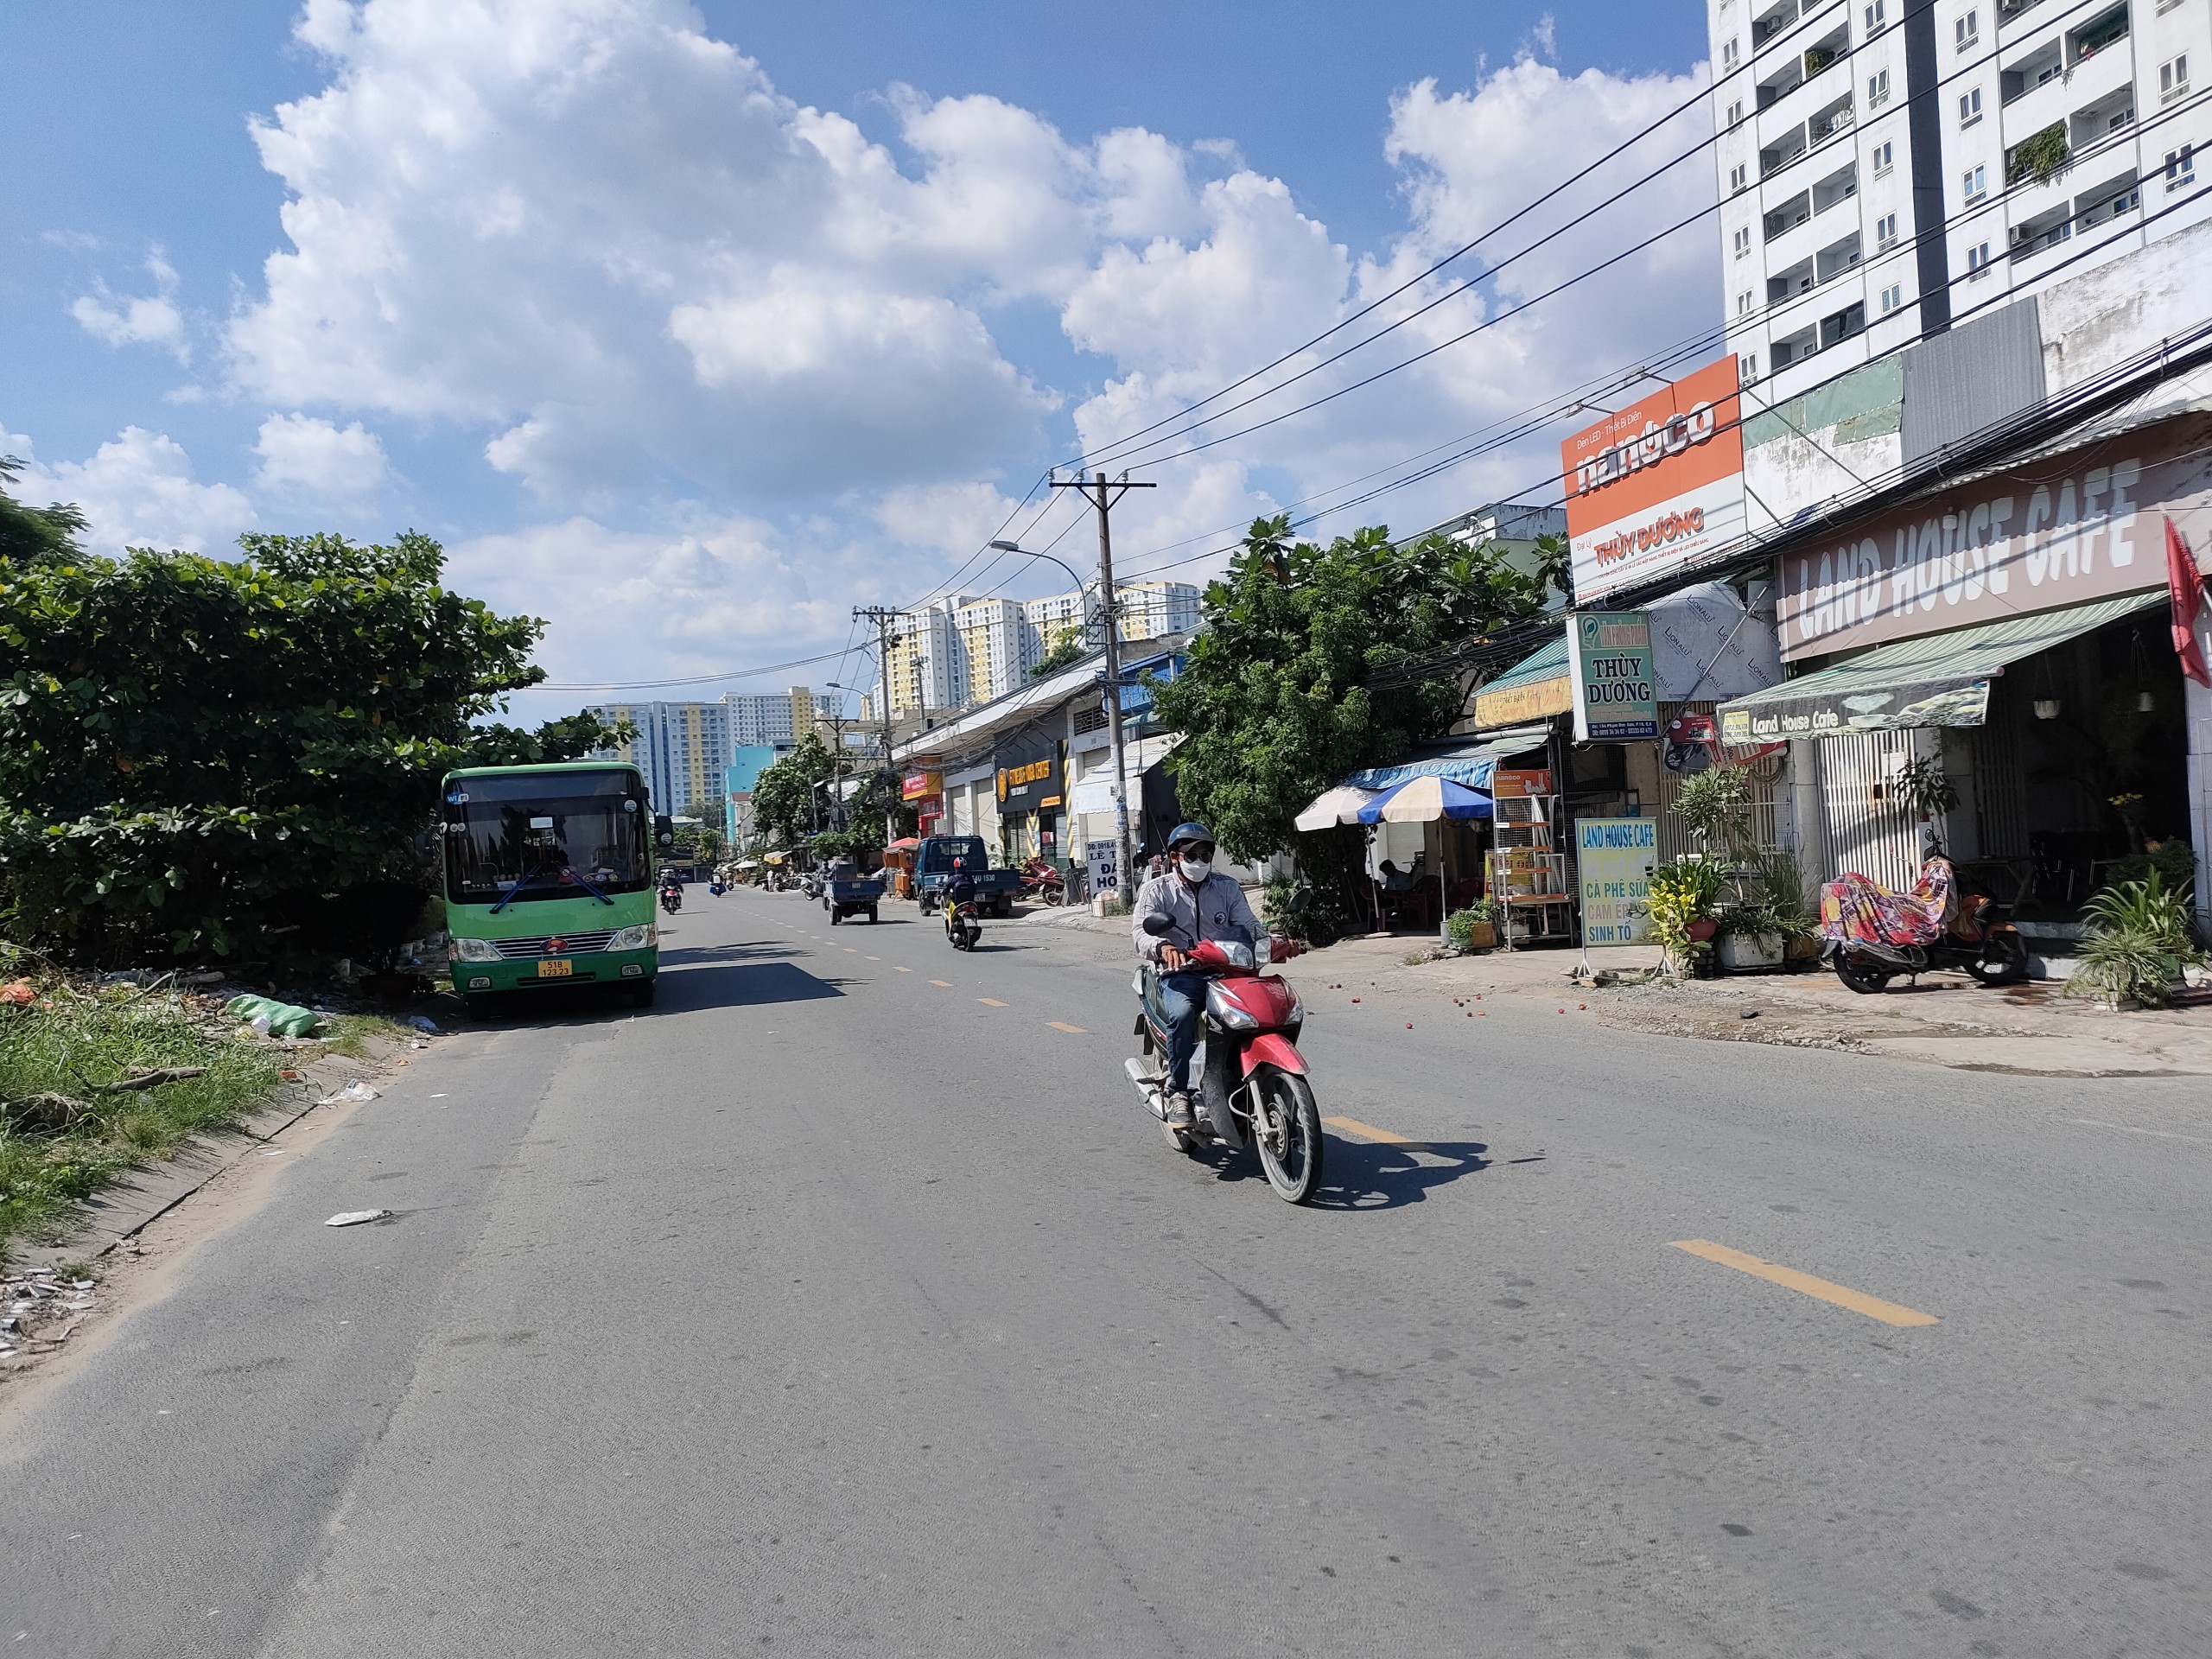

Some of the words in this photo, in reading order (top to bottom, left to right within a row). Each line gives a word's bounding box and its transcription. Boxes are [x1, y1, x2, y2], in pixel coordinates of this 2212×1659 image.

[1577, 436, 1590, 449] Đèn
[1590, 431, 1601, 443] LED
[1627, 411, 1642, 426] Điện
[1594, 529, 1636, 567] THÙY
[1637, 507, 1704, 552] DƯƠNG
[1797, 537, 1881, 640] LAND
[1891, 496, 2014, 619] HOUSE
[2024, 457, 2142, 588] CAFE
[1665, 626, 1690, 656] LIONALU
[1592, 653, 1641, 678] THÙY
[1588, 680, 1650, 703] DƯƠNG
[1753, 715, 1779, 734] Land
[1781, 712, 1809, 732] House
[1813, 708, 1839, 728] Cafe
[1582, 825, 1603, 848] LAND
[1606, 824, 1633, 848] HOUSE
[1634, 824, 1654, 847] CAFE
[1090, 850, 1105, 860] LÊ
[1586, 880, 1601, 898] CÀ
[1604, 879, 1625, 898] PHÊ
[1629, 878, 1650, 897] SỮA
[1588, 904, 1611, 920] CAM
[1589, 926, 1614, 941] SINH
[1618, 920, 1631, 940] TỐ
